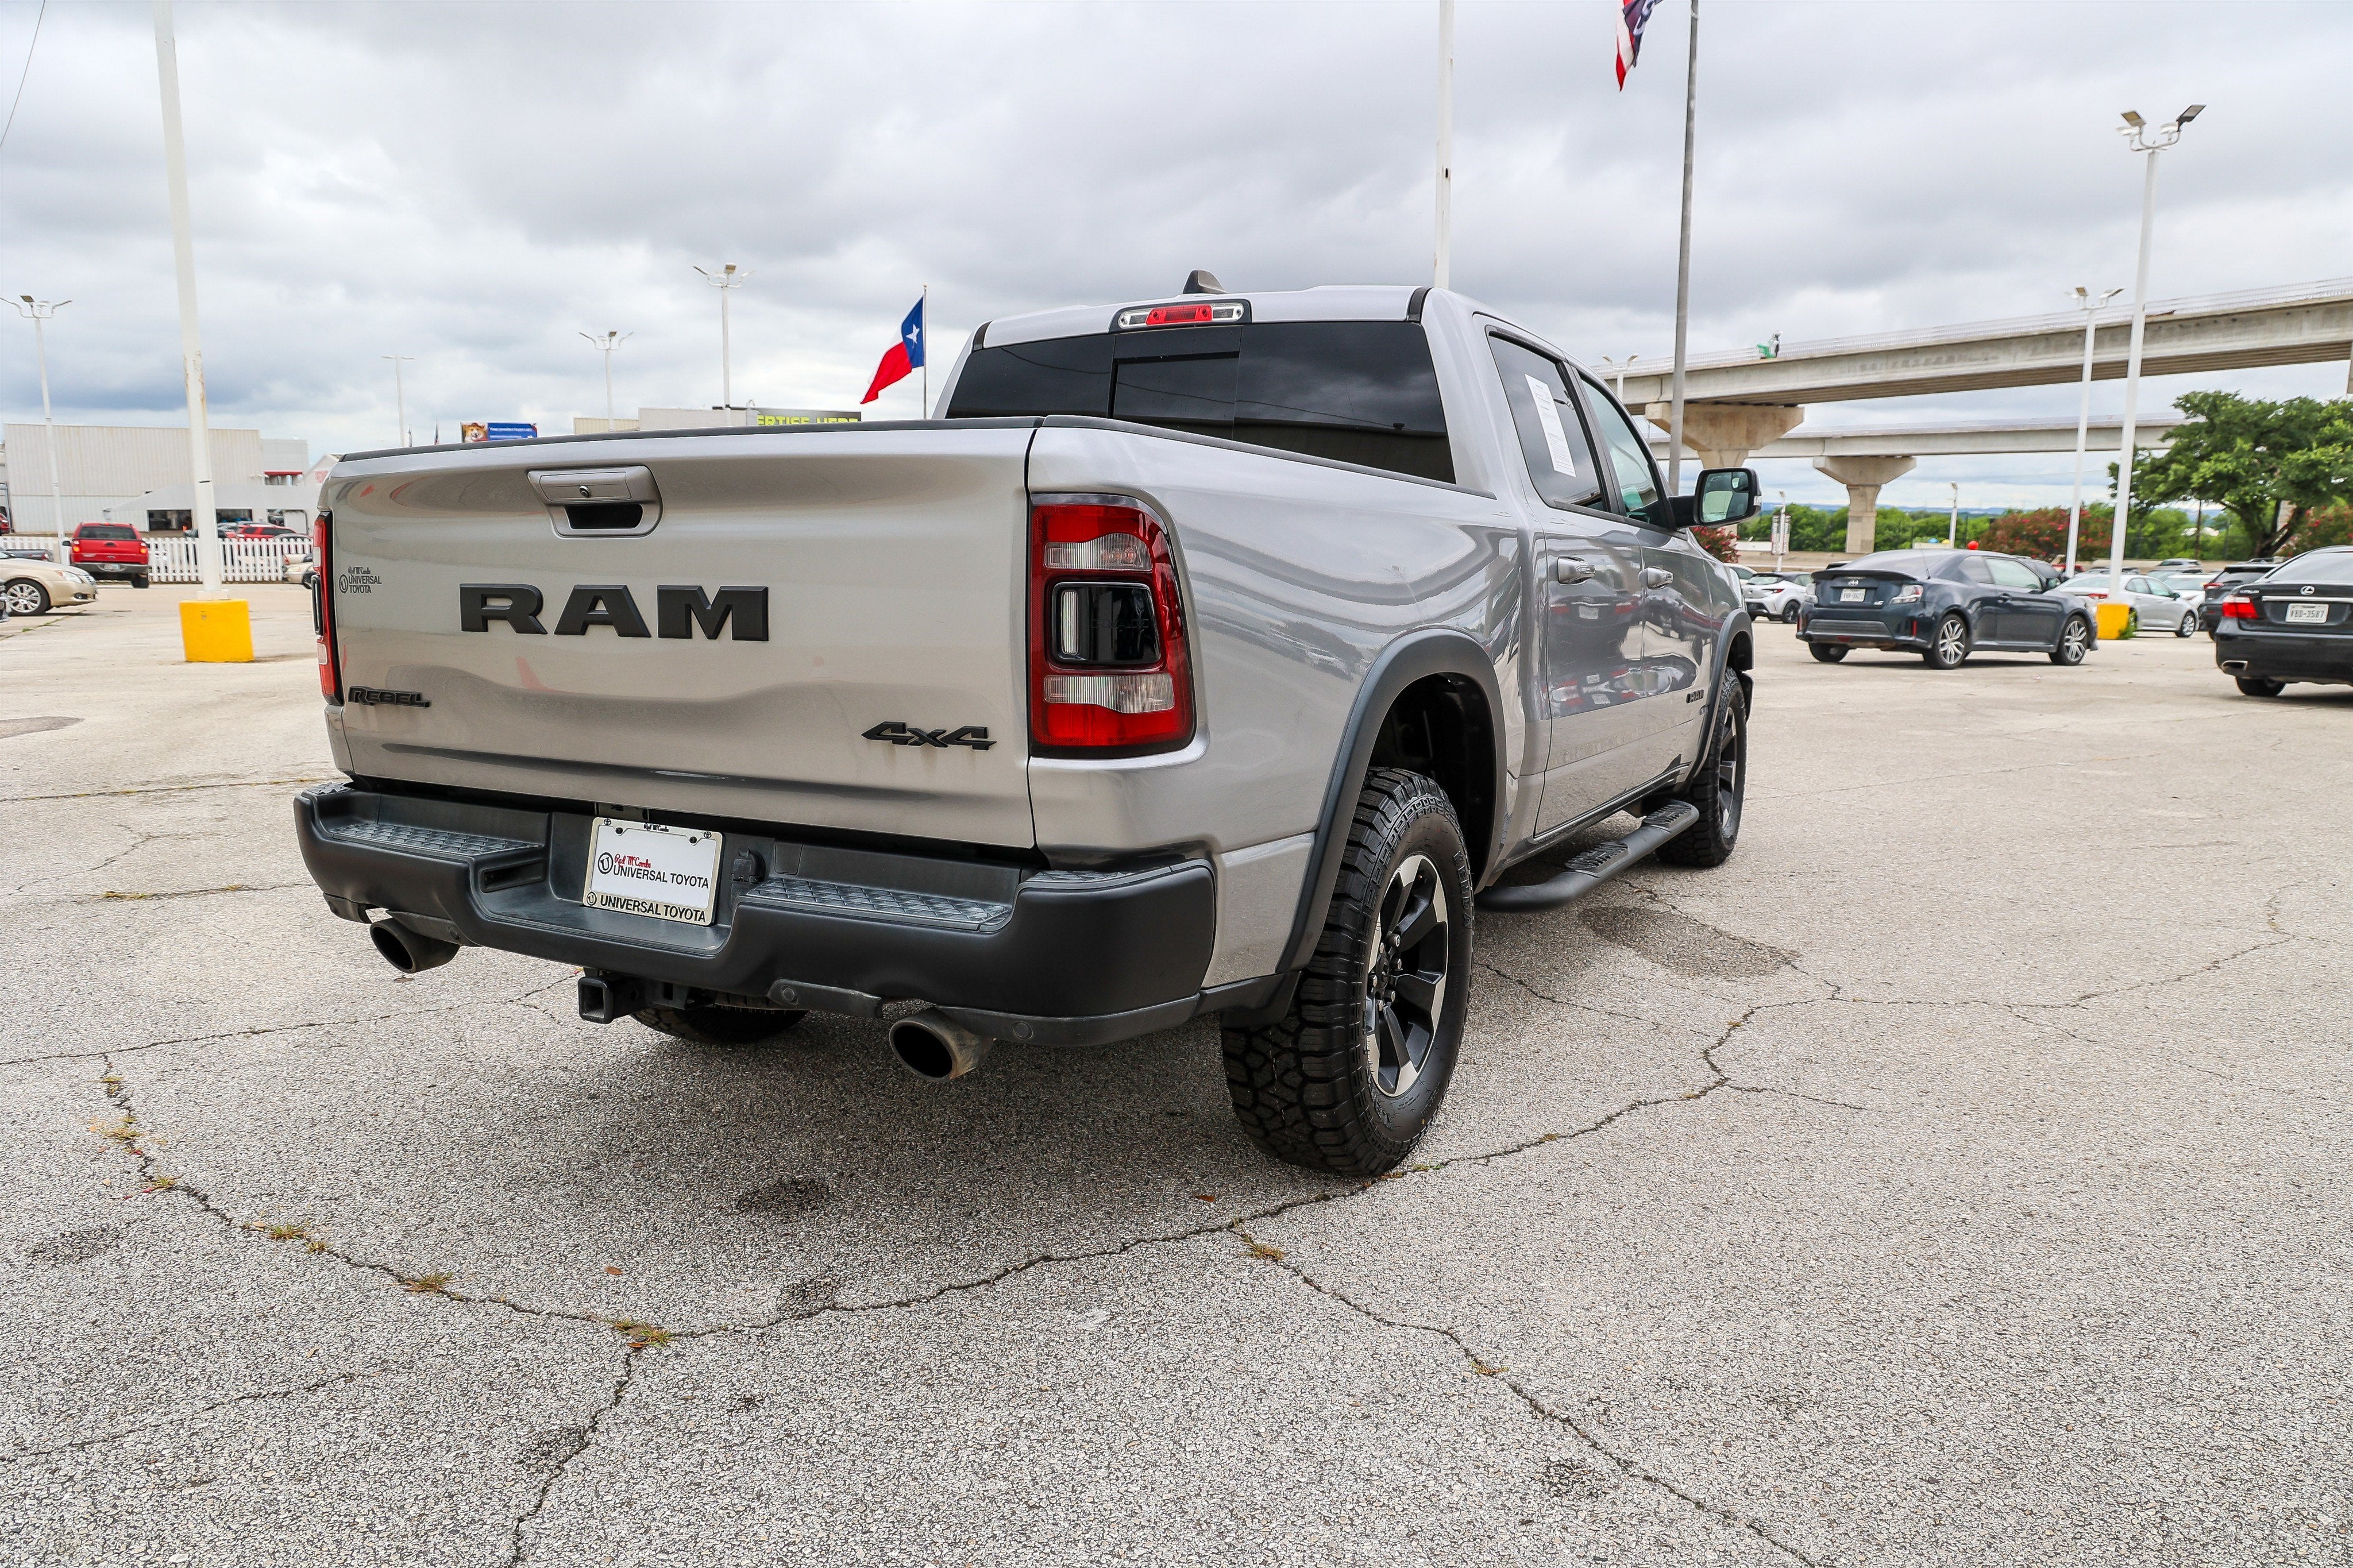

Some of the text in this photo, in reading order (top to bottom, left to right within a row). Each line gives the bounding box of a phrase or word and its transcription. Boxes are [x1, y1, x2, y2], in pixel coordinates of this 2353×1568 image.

[349, 576, 382, 584] UNIVERSAL
[349, 585, 372, 594] TOYOTA
[460, 584, 769, 642] RAM
[348, 685, 430, 708] REBEL
[614, 853, 626, 868] Red
[614, 864, 709, 889] UNIVERSAL TOYOTA
[1453, 850, 1472, 927] KENDA
[600, 895, 707, 923] UNIVERSAL TOYOTA
